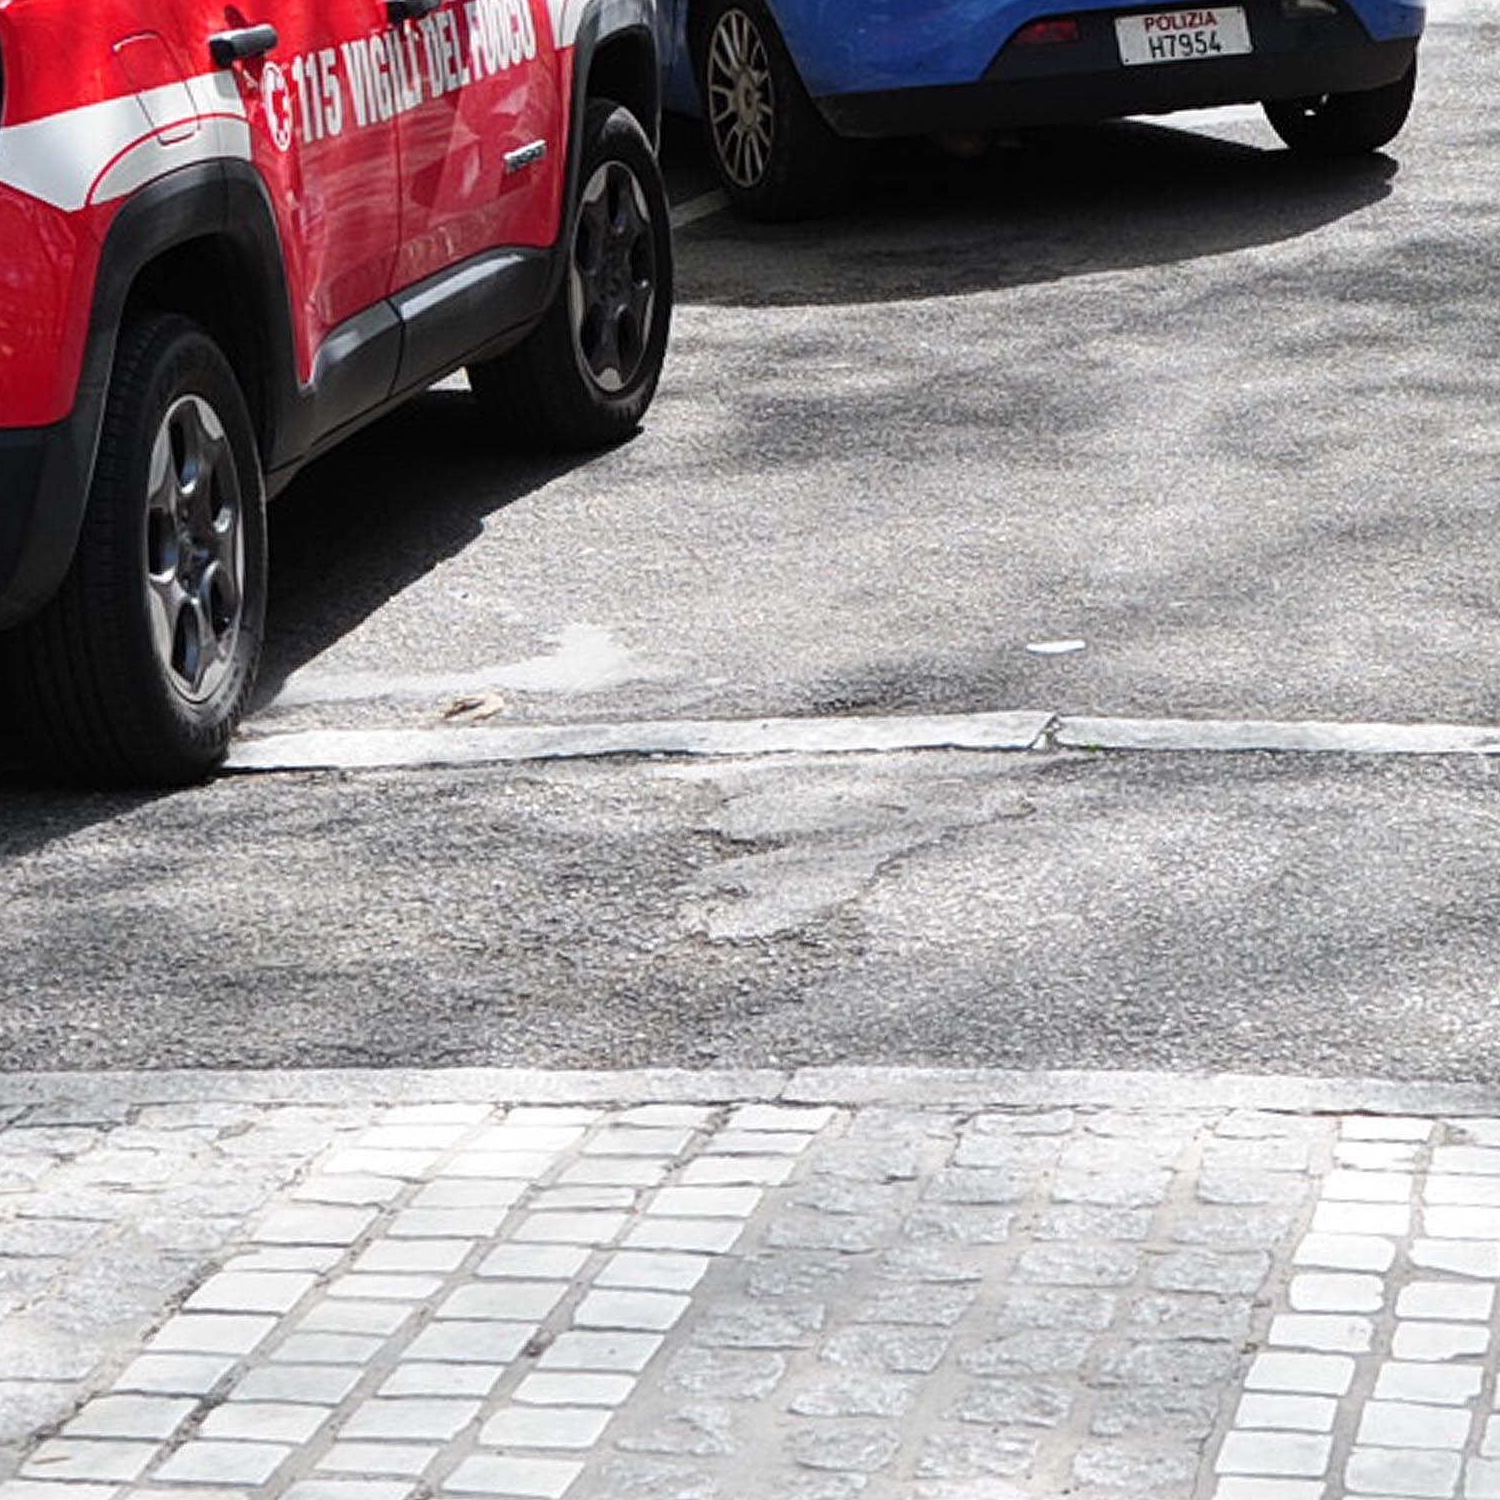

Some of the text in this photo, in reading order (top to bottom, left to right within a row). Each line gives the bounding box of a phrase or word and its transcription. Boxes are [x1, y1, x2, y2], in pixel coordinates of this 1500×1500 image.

[1144, 10, 1218, 32] POLIZIA
[1148, 30, 1223, 59] H7954
[290, 47, 343, 144] 115
[340, 18, 423, 127] VIGILI
[419, 8, 471, 99] DEL
